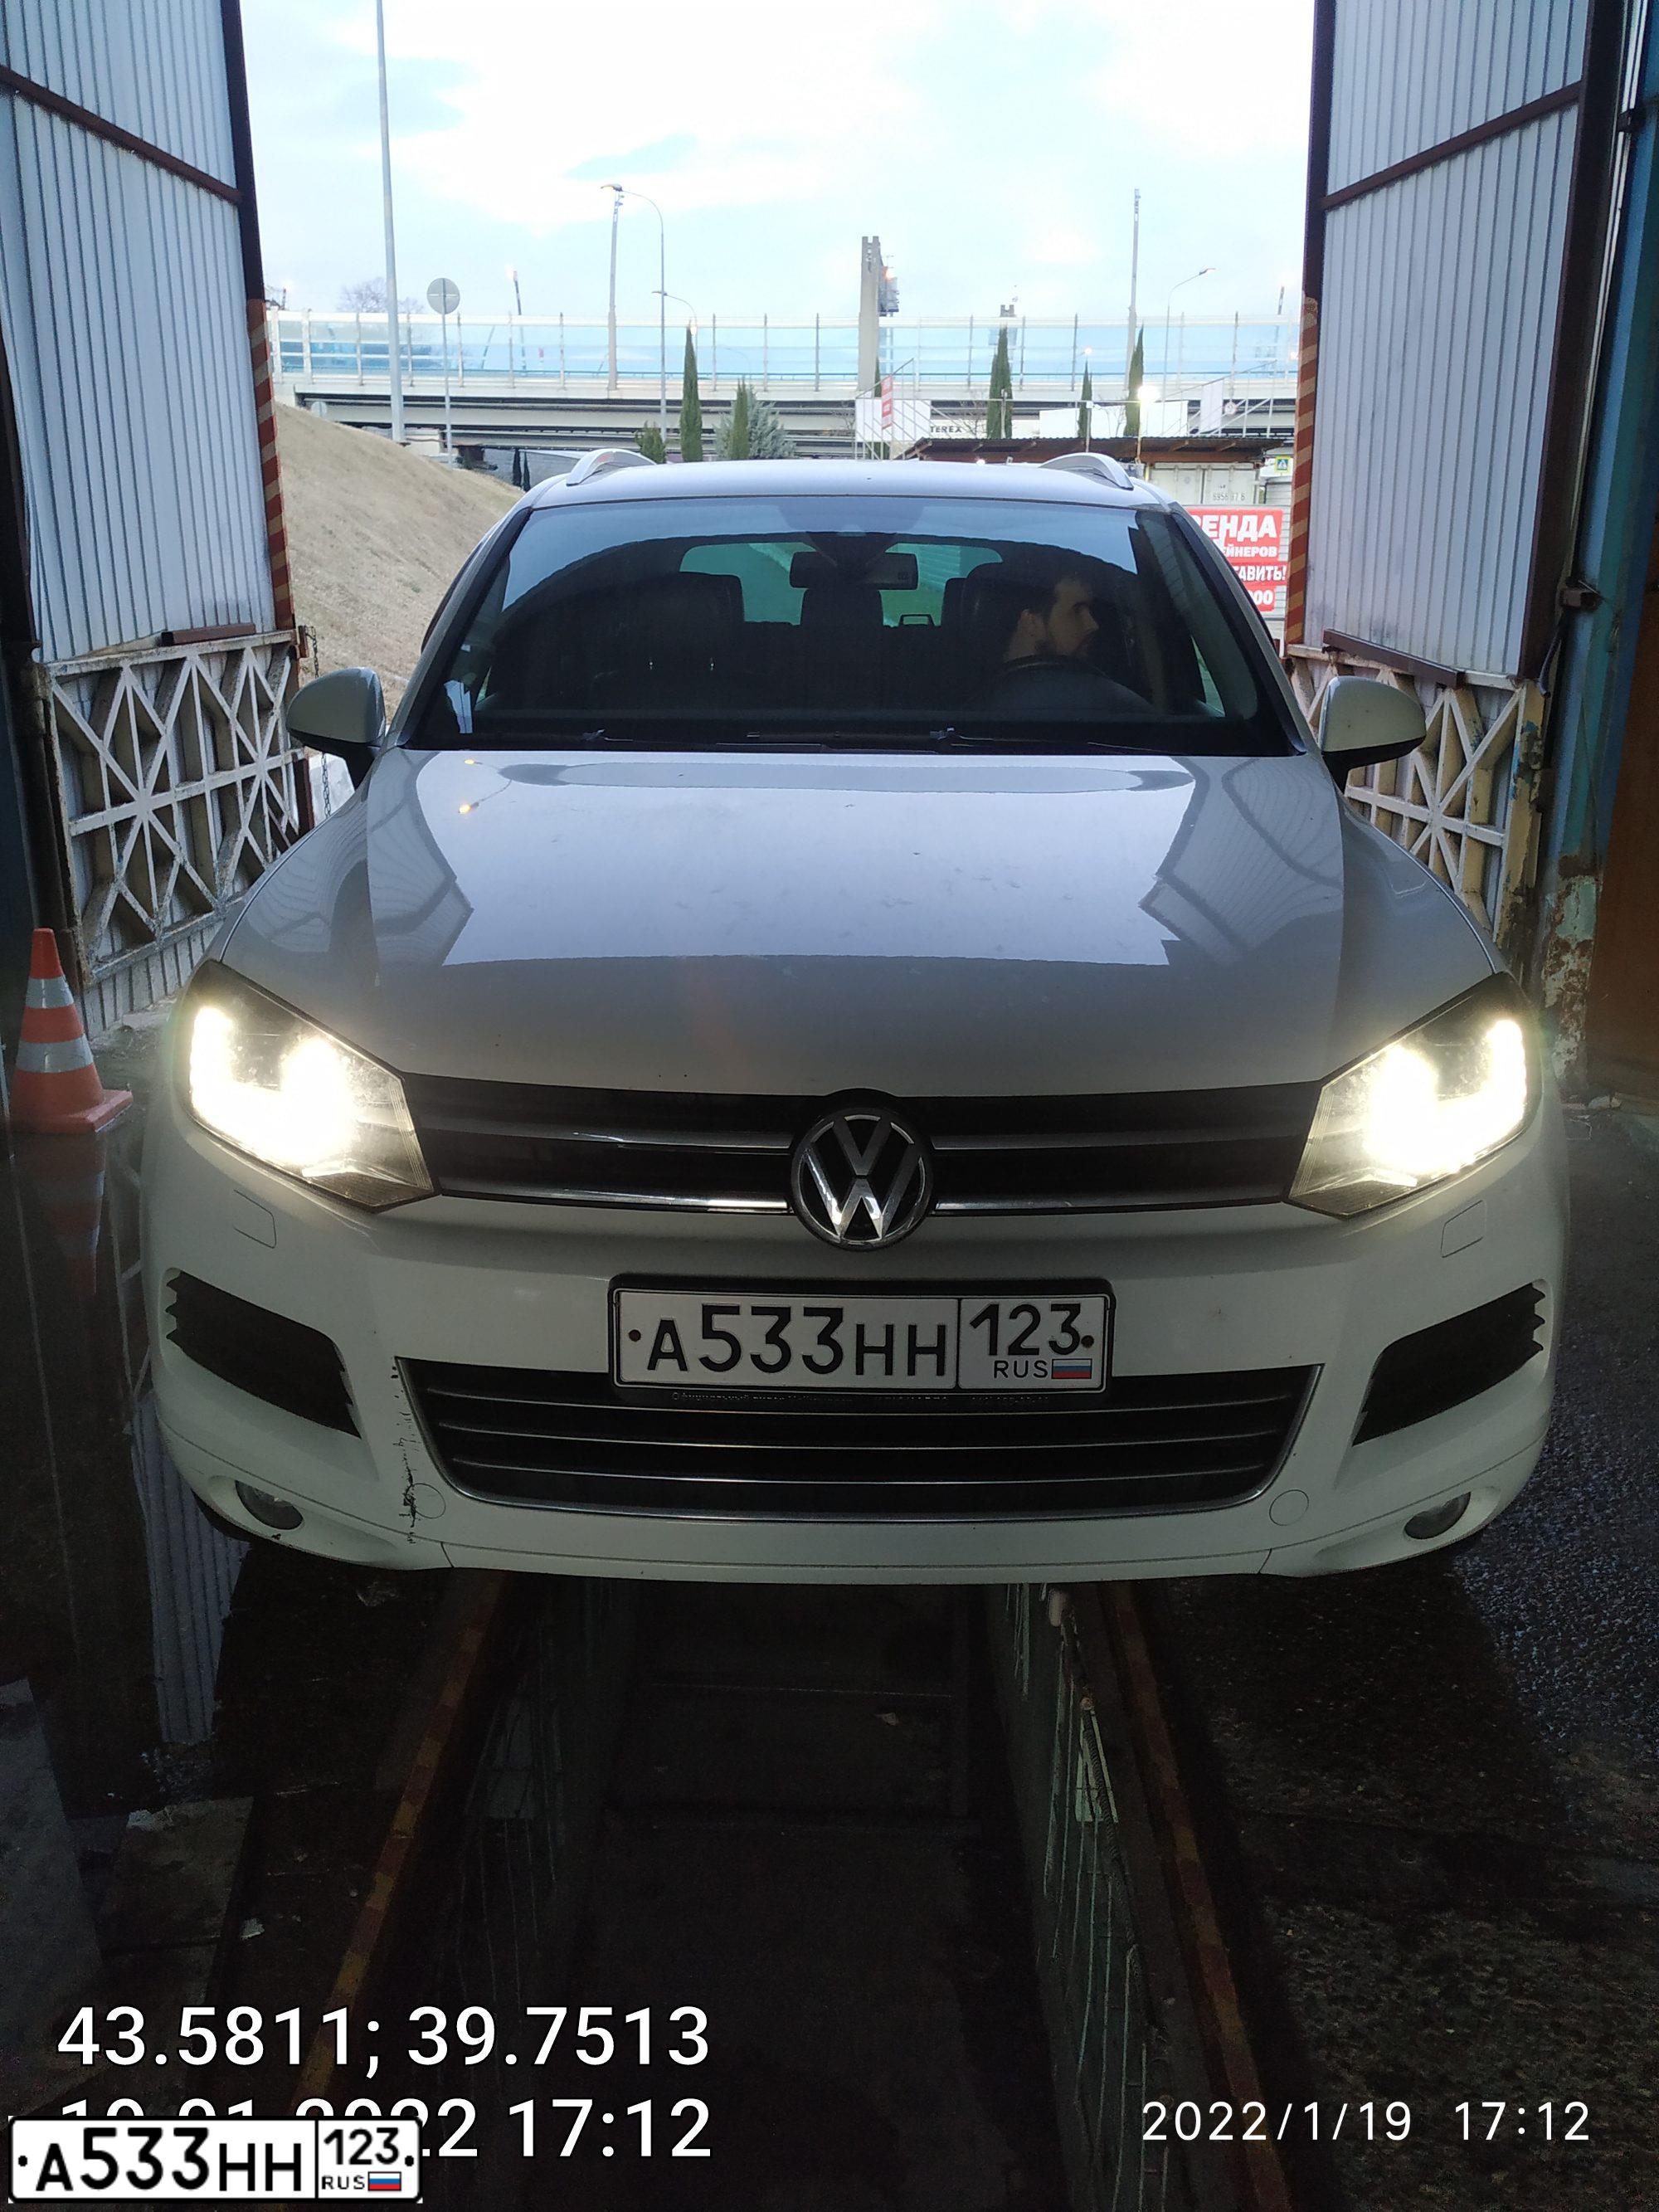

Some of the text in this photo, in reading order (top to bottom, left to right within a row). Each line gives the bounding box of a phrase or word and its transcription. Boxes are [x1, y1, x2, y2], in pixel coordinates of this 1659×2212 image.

[930, 426, 963, 434] TEREX
[1248, 589, 1274, 606] 00
[646, 1303, 946, 1375] А533НН
[969, 1303, 1082, 1356] 123
[994, 1360, 1048, 1379] RUS
